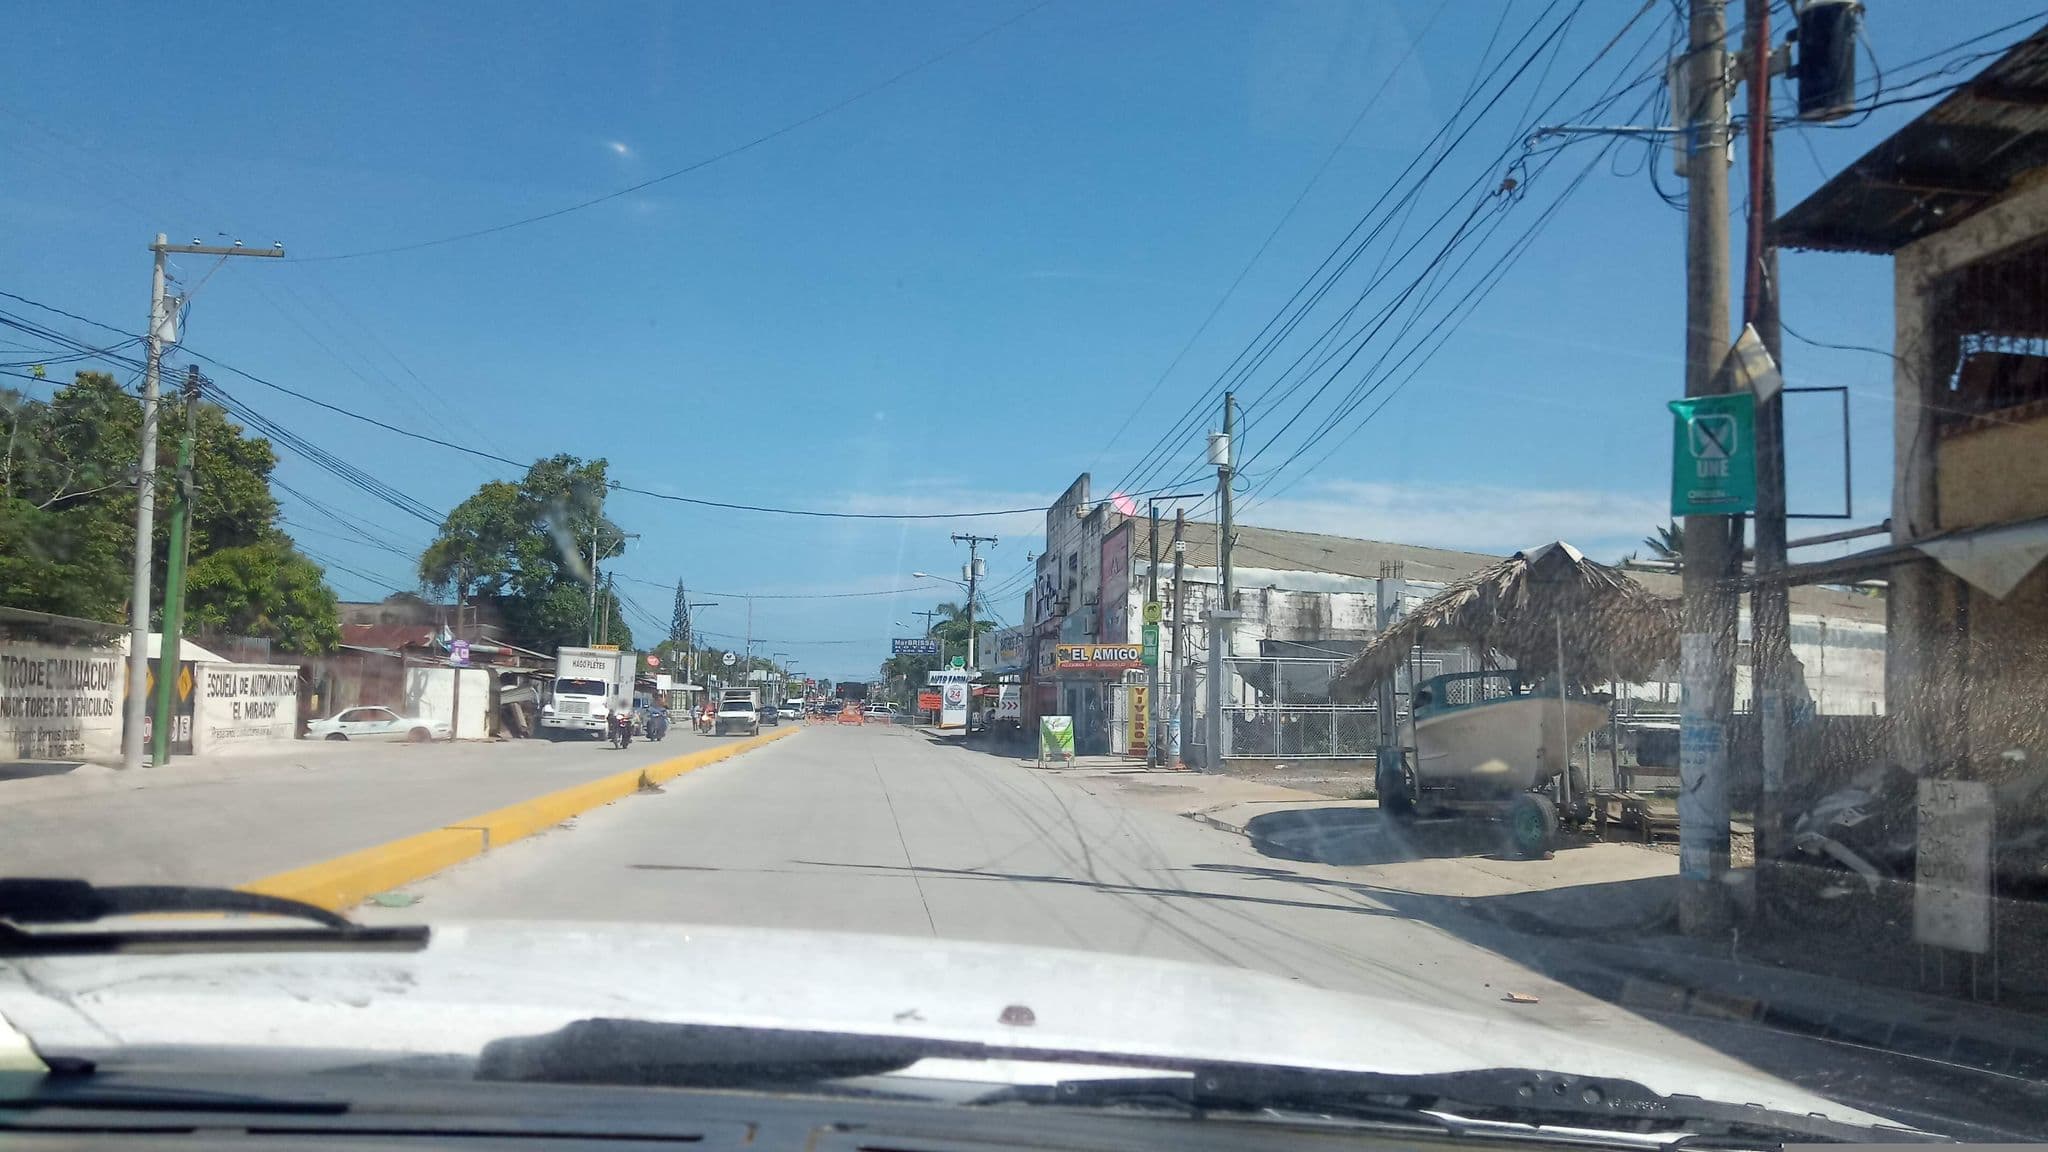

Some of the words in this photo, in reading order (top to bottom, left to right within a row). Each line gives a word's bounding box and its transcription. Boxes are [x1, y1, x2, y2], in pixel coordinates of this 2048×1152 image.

[1072, 648, 1088, 661] EL
[1093, 648, 1138, 661] AMIGO
[587, 659, 606, 670] FLETES
[29, 660, 44, 686] DE
[46, 658, 116, 691] EVALUACION
[931, 675, 948, 684] AUTO
[206, 672, 237, 698] ESCUELA
[239, 677, 249, 695] DE
[249, 673, 297, 697] AUTOMOVILISMO
[949, 690, 961, 699] 24
[56, 696, 68, 718] DE
[71, 697, 114, 719] VEHICULOS
[1134, 687, 1145, 739] VIVERO
